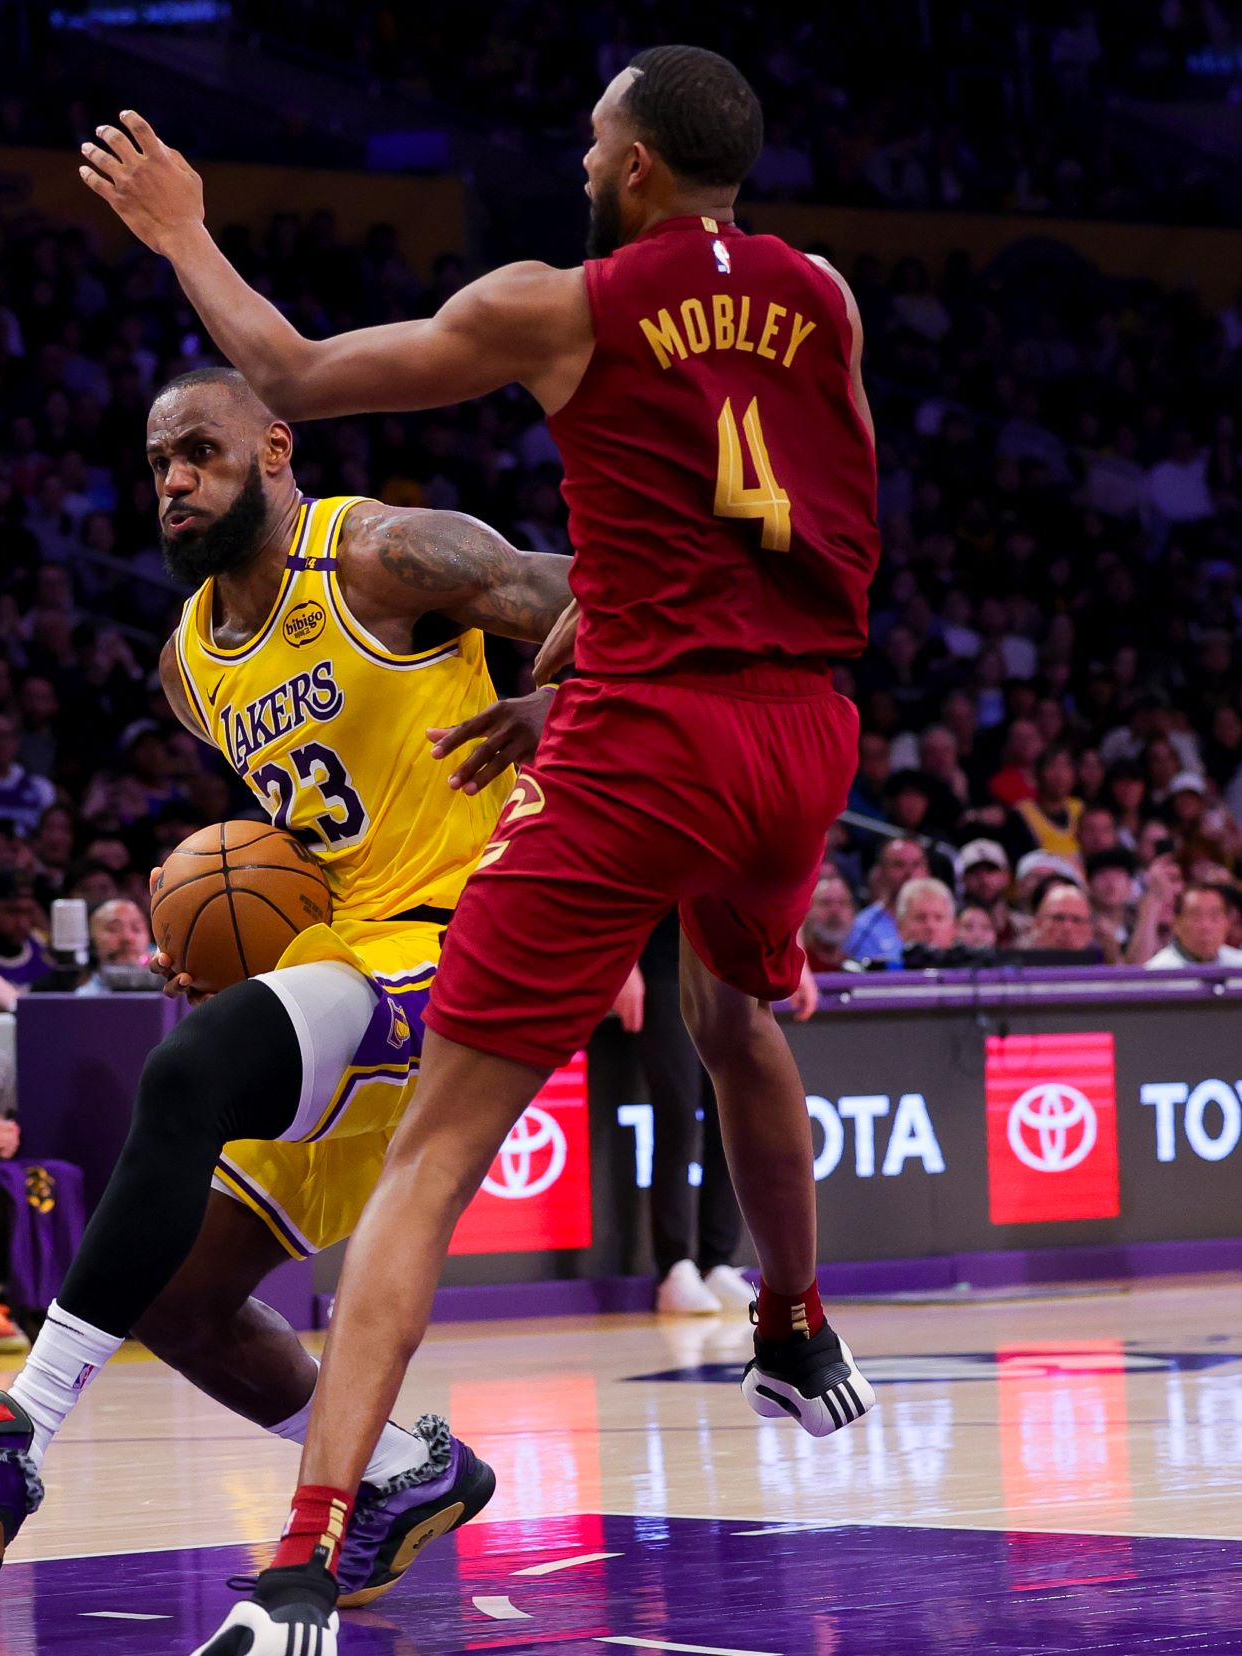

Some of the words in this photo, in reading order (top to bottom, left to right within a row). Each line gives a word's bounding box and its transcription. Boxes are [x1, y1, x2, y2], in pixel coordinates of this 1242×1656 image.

[638, 293, 817, 371] MOBLEY
[713, 394, 792, 553] 4
[285, 610, 324, 637] bibigo
[220, 658, 346, 779] LAKERS
[248, 739, 372, 852] 23
[1139, 1078, 1242, 1163] TO
